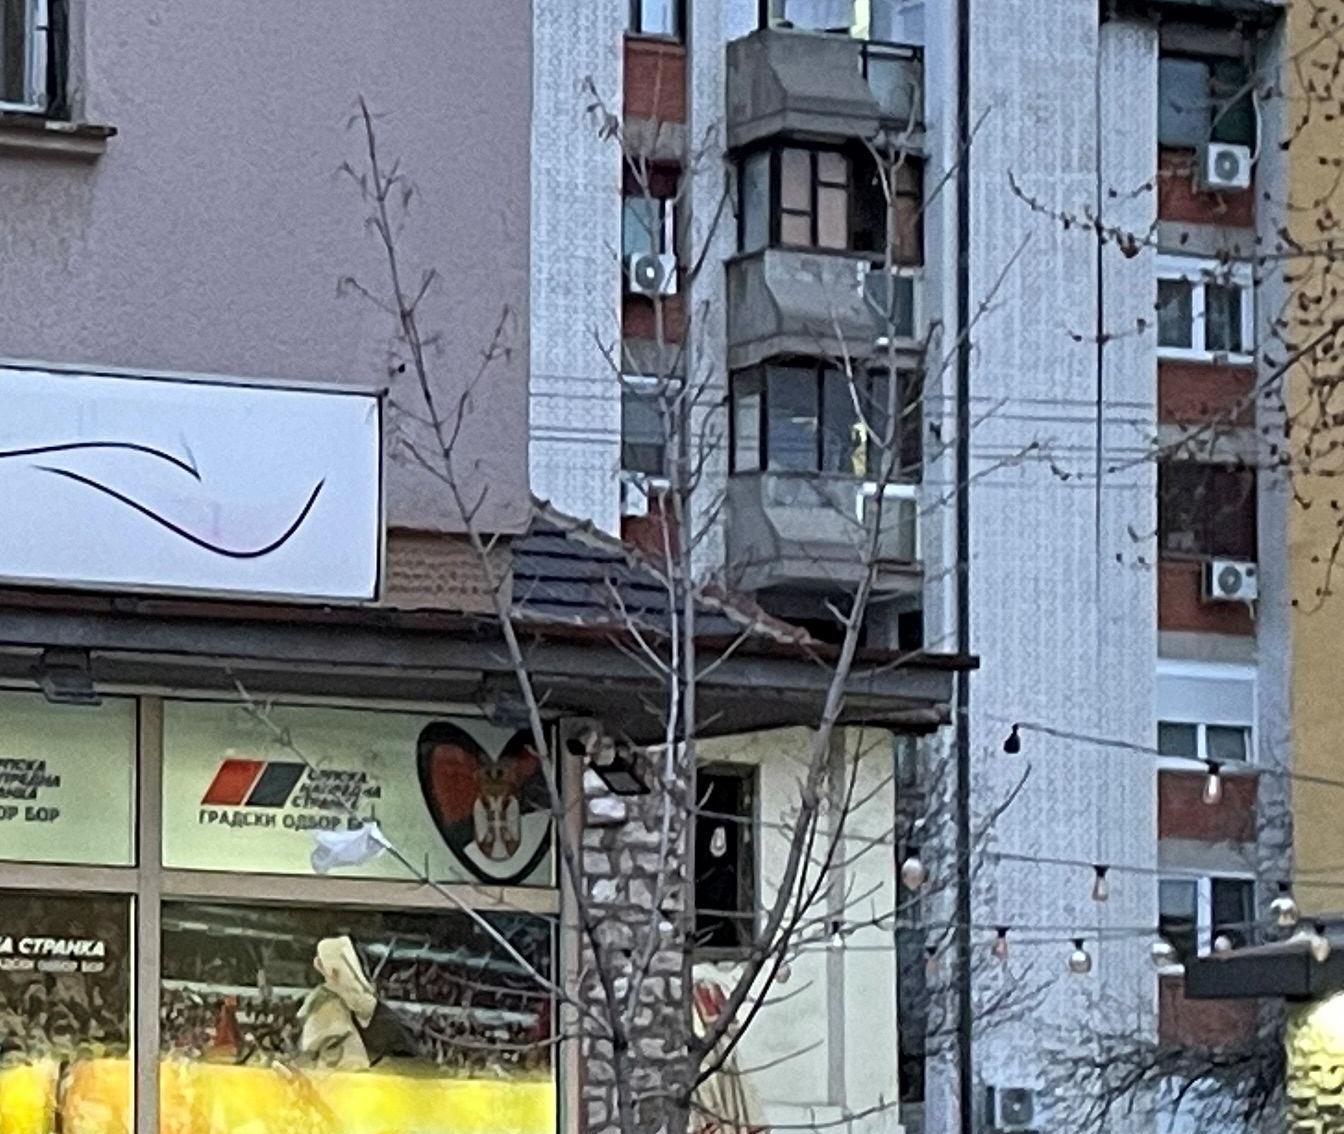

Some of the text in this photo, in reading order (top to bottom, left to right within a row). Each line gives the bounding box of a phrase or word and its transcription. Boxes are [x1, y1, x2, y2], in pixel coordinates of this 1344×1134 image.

[24, 806, 61, 823] БОР
[198, 808, 277, 829] ГРАДСКИ
[281, 813, 342, 832] ОДБОР
[17, 936, 107, 957] СТРАНКА
